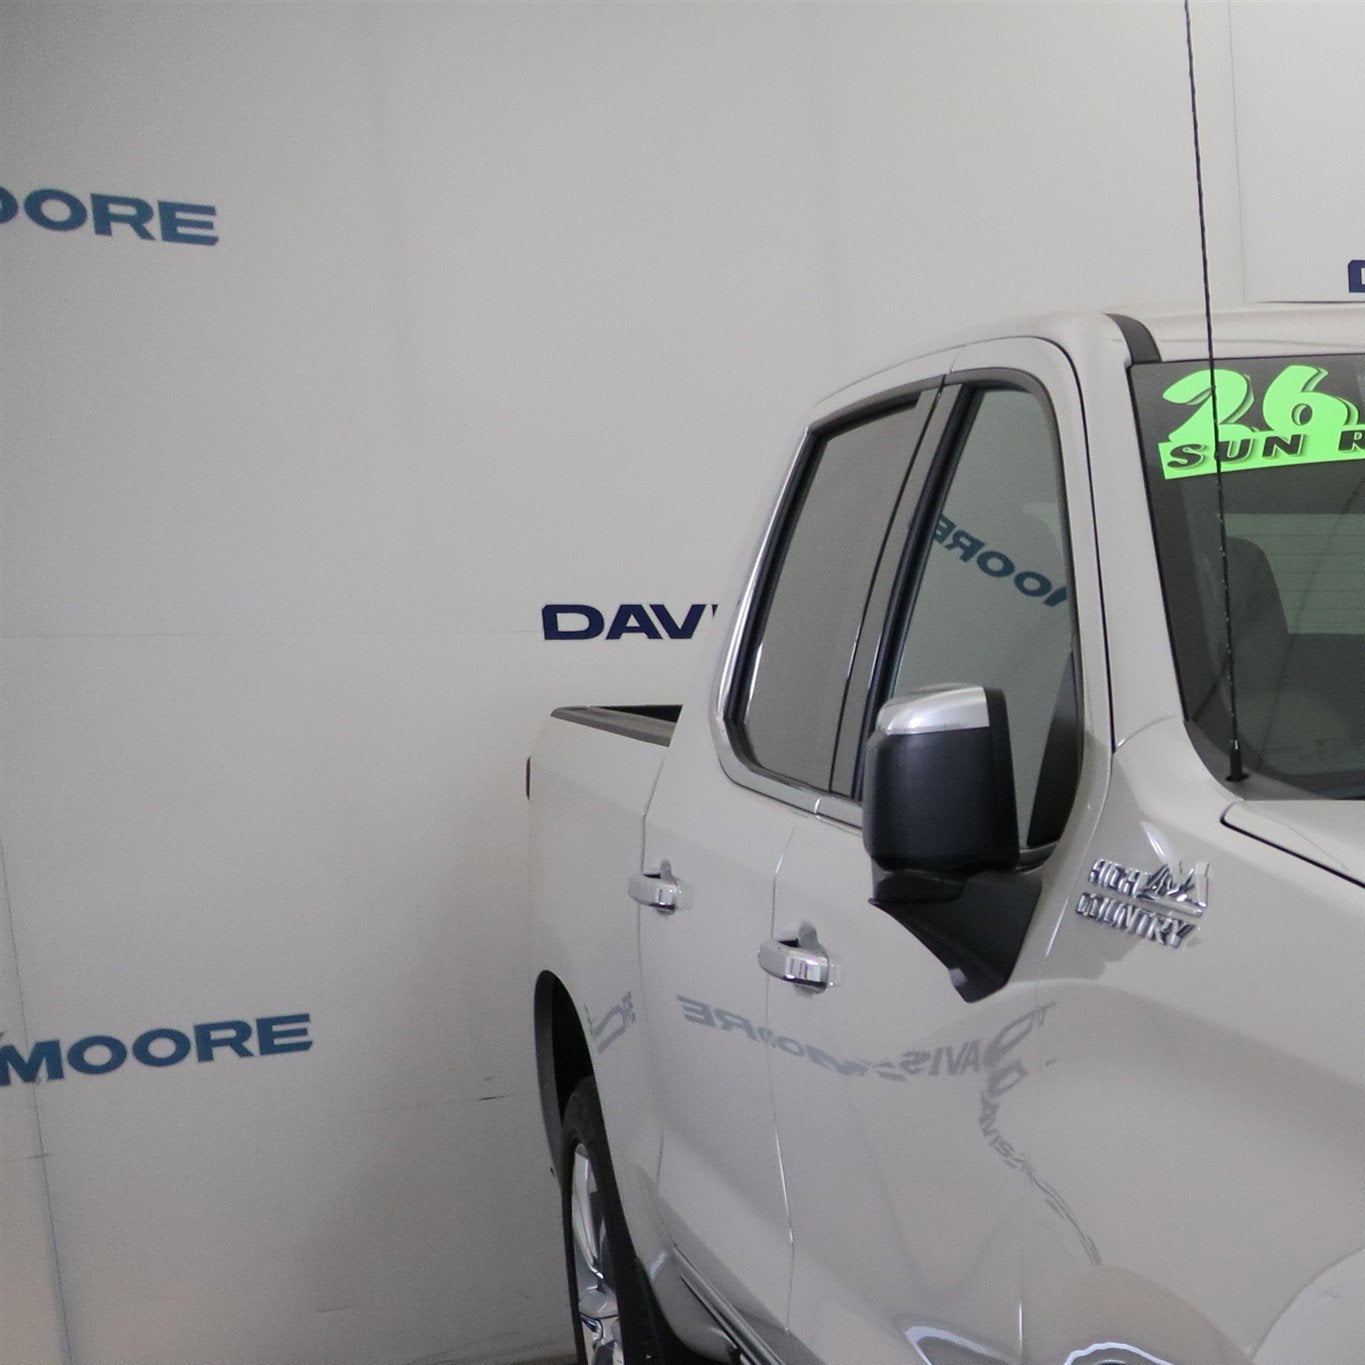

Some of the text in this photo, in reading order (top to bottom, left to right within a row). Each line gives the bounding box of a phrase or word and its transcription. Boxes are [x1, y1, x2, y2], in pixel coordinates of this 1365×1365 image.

[1163, 365, 1359, 442] 26
[1167, 433, 1305, 469] SUN
[542, 604, 718, 640] DAV
[0, 1013, 313, 1087] MOORE
